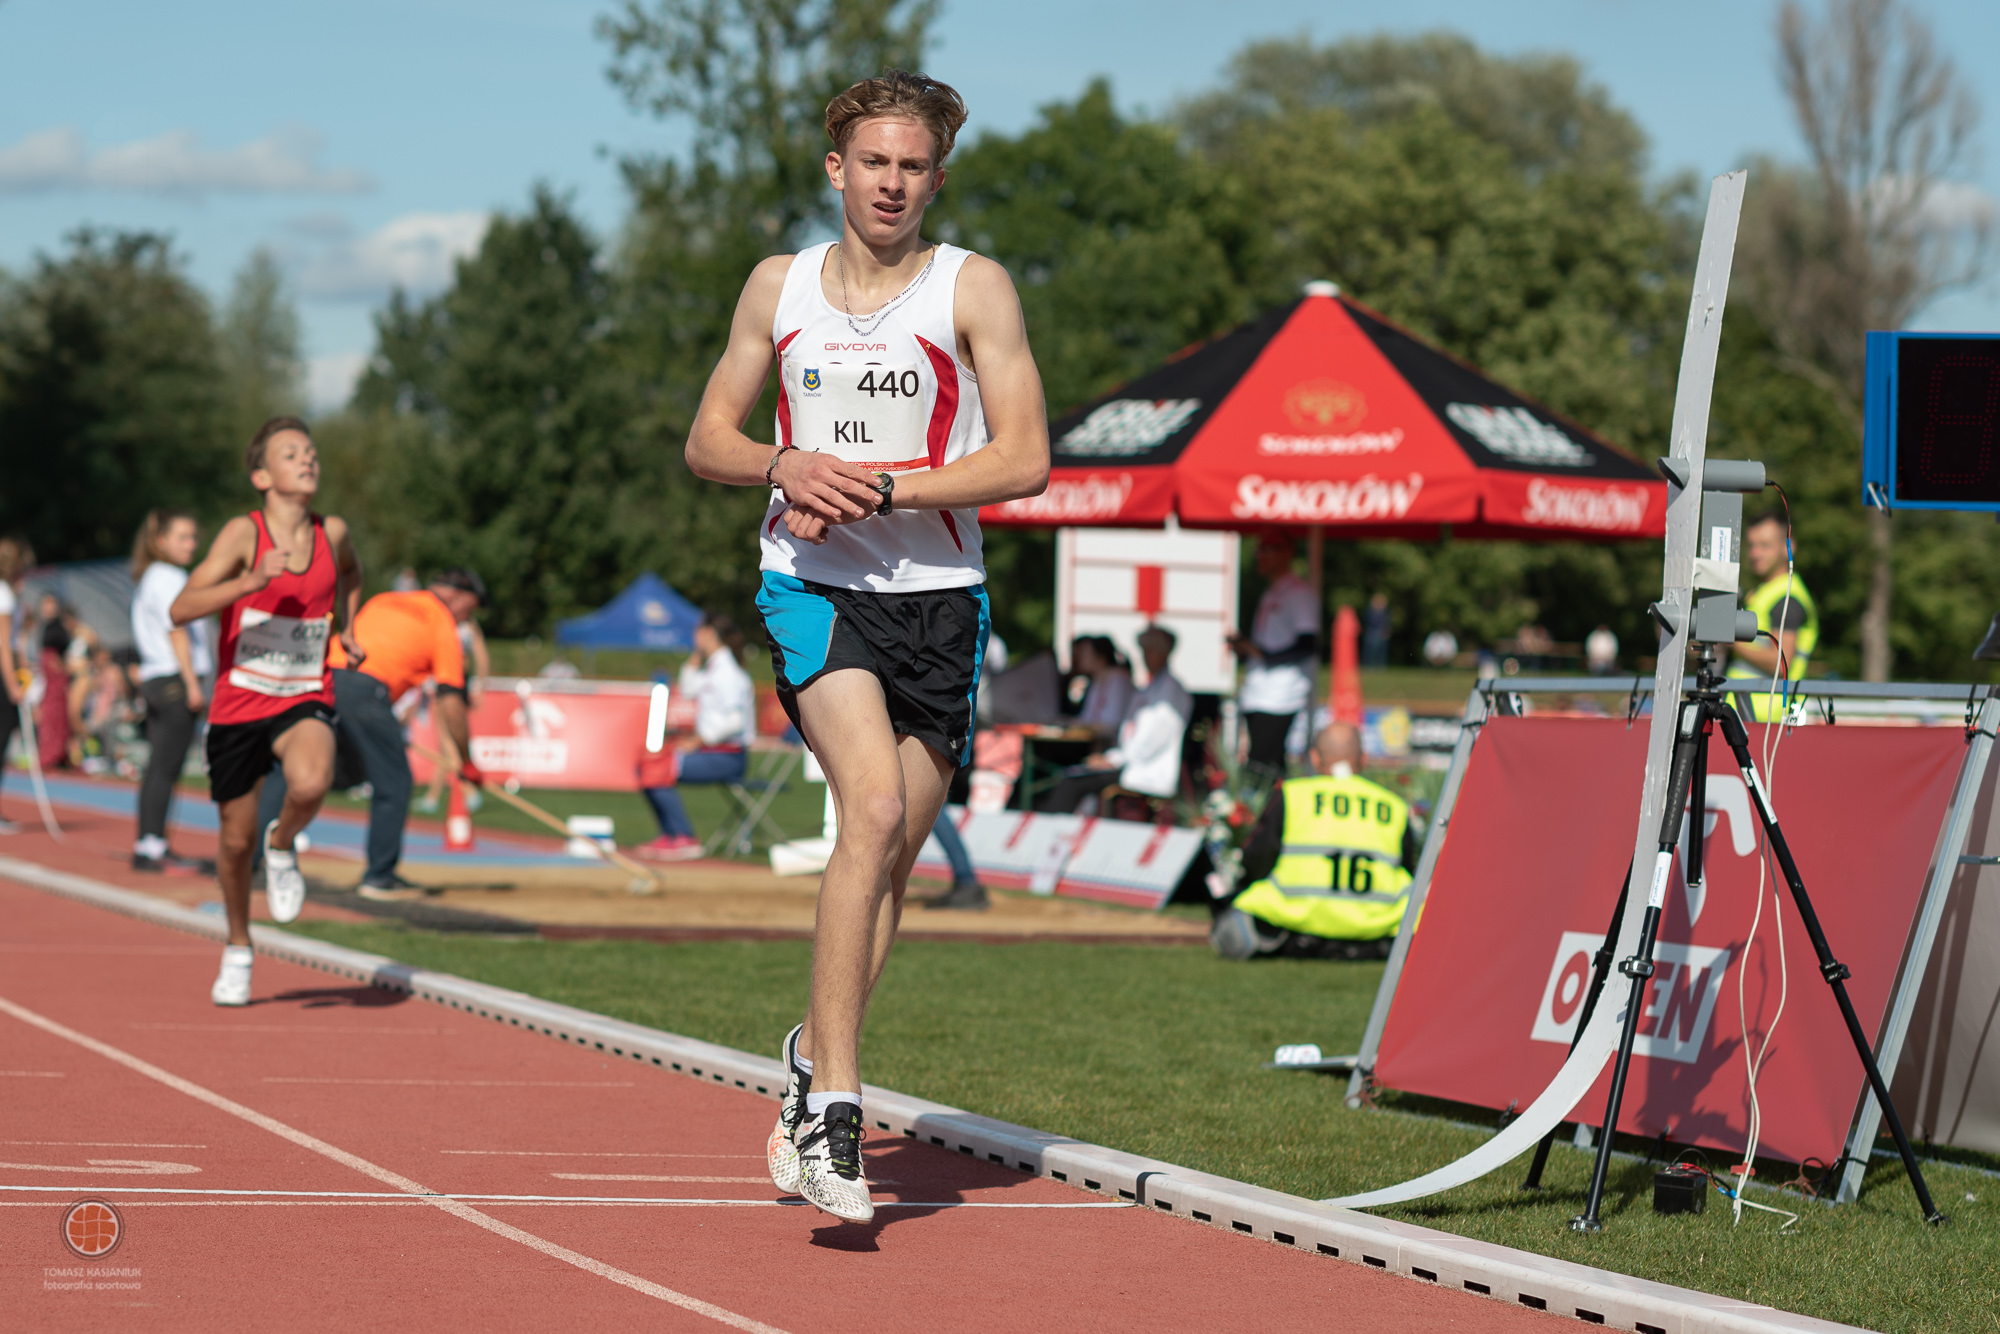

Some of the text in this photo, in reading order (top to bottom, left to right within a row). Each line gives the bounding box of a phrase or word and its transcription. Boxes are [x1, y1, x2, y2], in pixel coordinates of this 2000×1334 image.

[824, 342, 887, 352] GIVOVA
[857, 370, 920, 398] 440
[834, 420, 873, 444] KIL
[291, 623, 326, 642] 602
[1315, 793, 1392, 824] FOTO
[1325, 852, 1373, 895] 16
